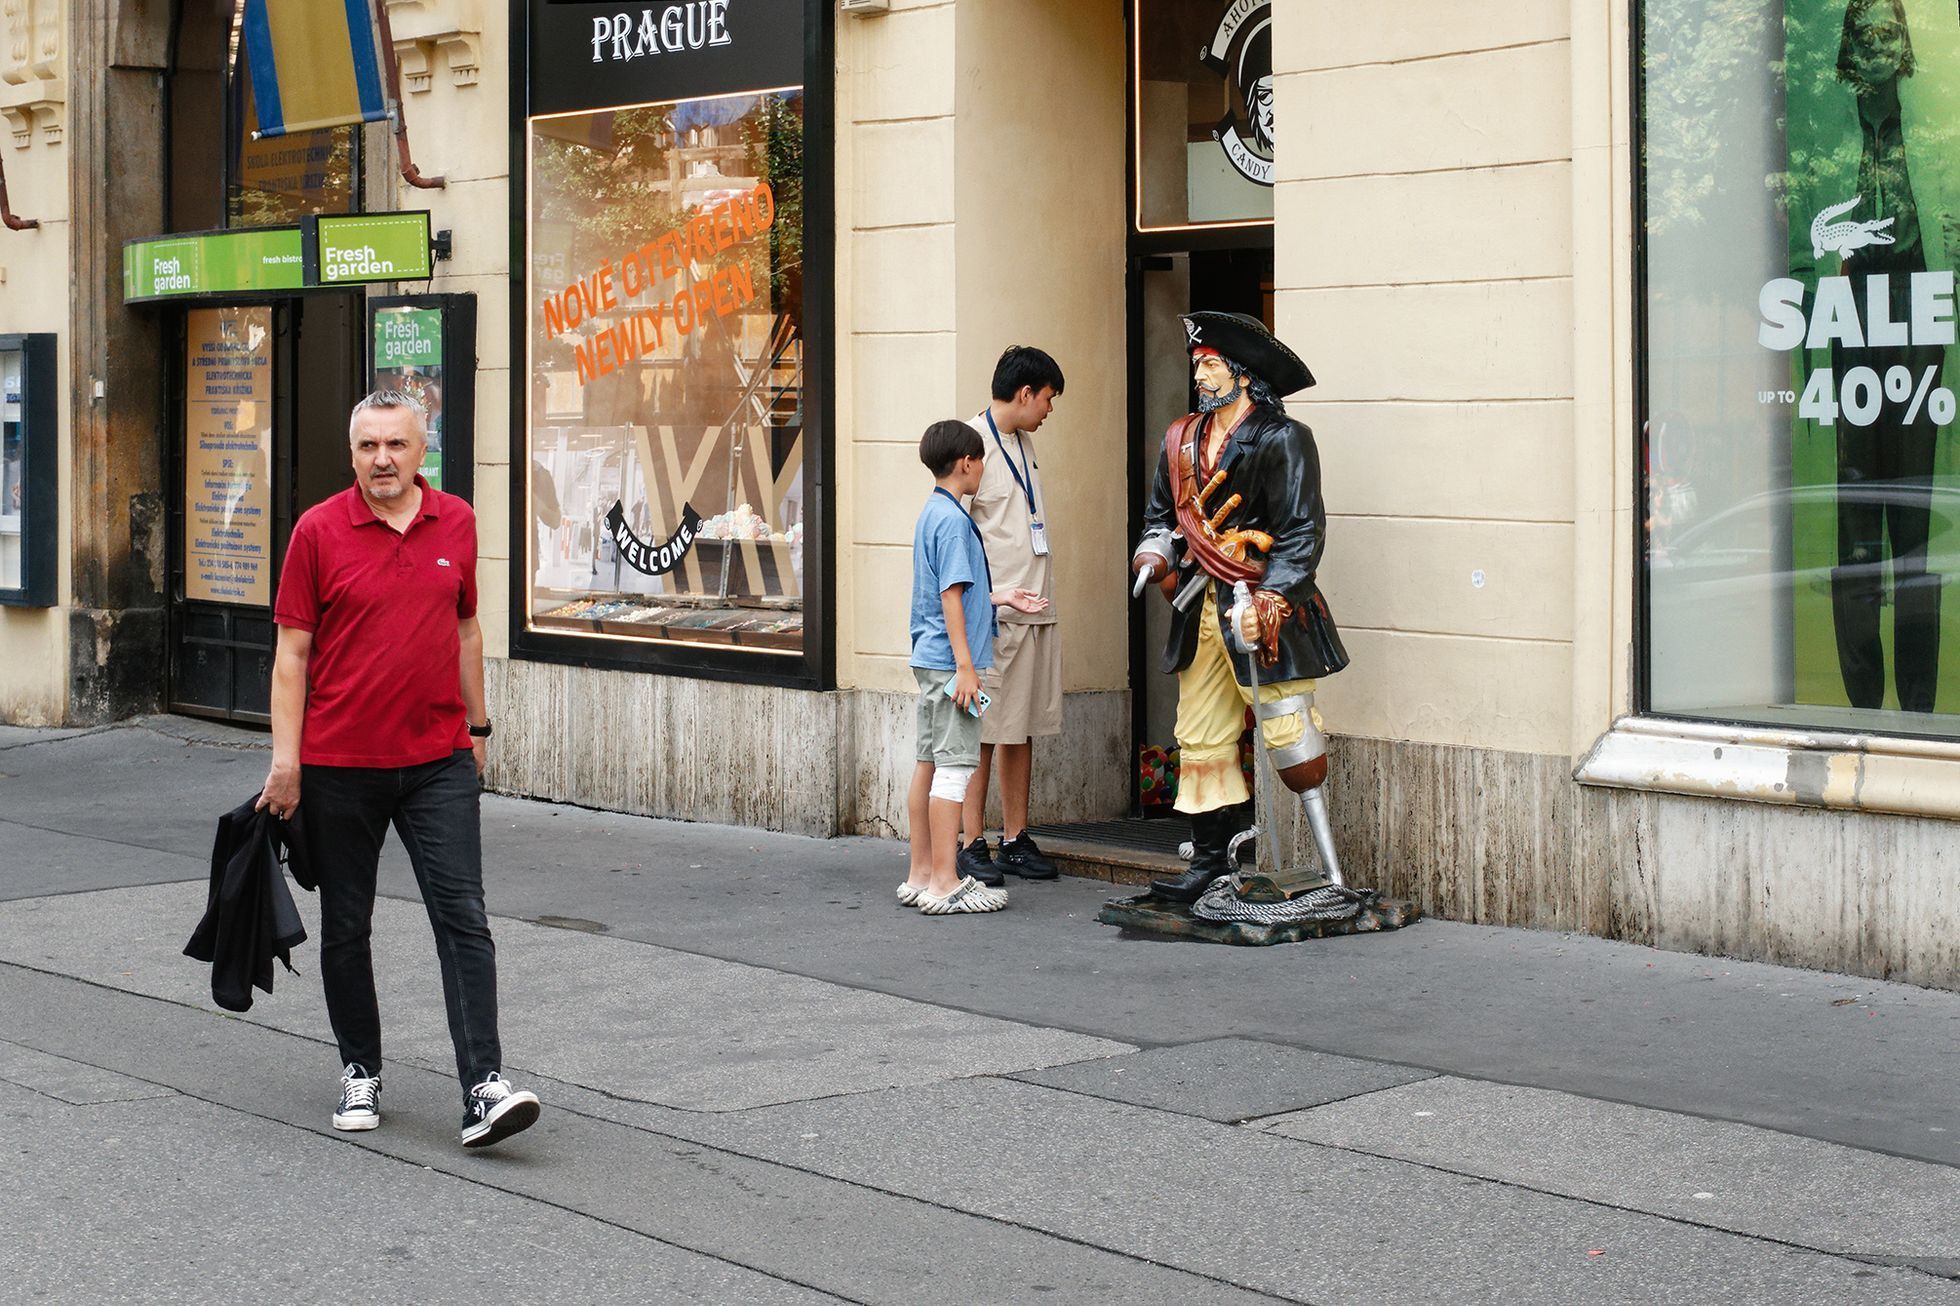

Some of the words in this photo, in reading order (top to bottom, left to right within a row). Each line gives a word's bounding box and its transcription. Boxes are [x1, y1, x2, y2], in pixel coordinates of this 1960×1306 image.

[591, 0, 732, 62] PRAGUE
[1231, 143, 1271, 179] CANDY
[154, 256, 180, 275] Fresh
[262, 255, 281, 264] fresh
[325, 245, 375, 262] Fresh
[544, 258, 617, 341] NOVĚ
[621, 182, 775, 298] OTEVŘENO
[154, 273, 190, 294] garden
[326, 259, 393, 280] garden
[575, 301, 665, 386] NEWLY
[672, 261, 754, 336] OPEN
[1758, 271, 1955, 350] SALE
[385, 320, 419, 338] Fresh
[385, 337, 431, 360] garden
[1758, 391, 1775, 403] UP
[1777, 390, 1795, 403] TO
[1799, 365, 1956, 426] 40%
[616, 521, 692, 572] WELCOME
